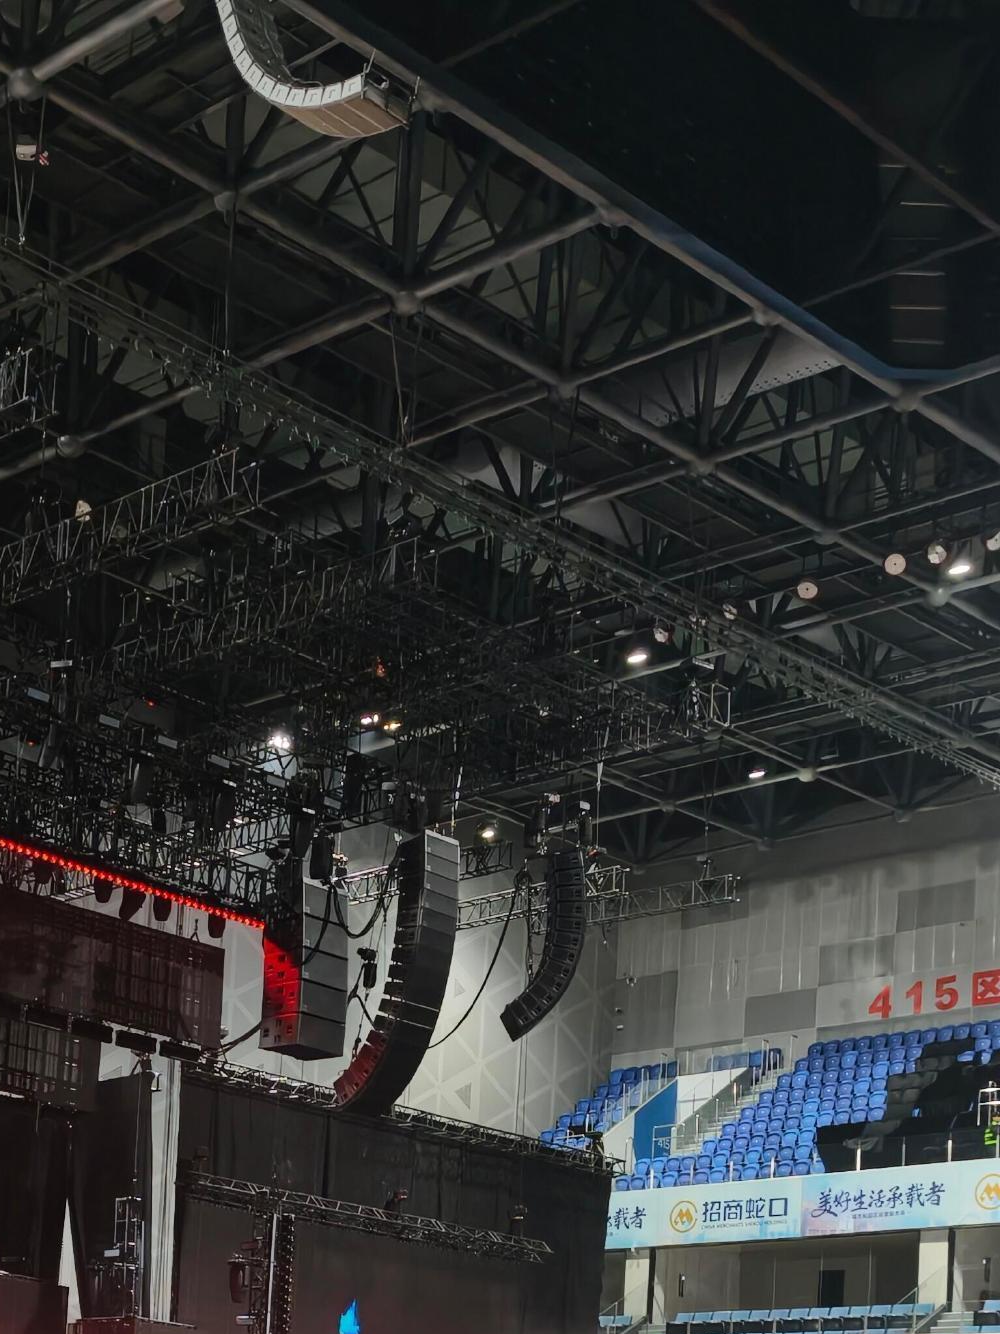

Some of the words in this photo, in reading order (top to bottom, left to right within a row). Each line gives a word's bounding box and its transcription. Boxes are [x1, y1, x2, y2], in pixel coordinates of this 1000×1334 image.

[868, 968, 1000, 1019] 415区
[702, 1197, 789, 1223] 招商蛇口
[811, 1181, 946, 1218] 美好生活承载者
